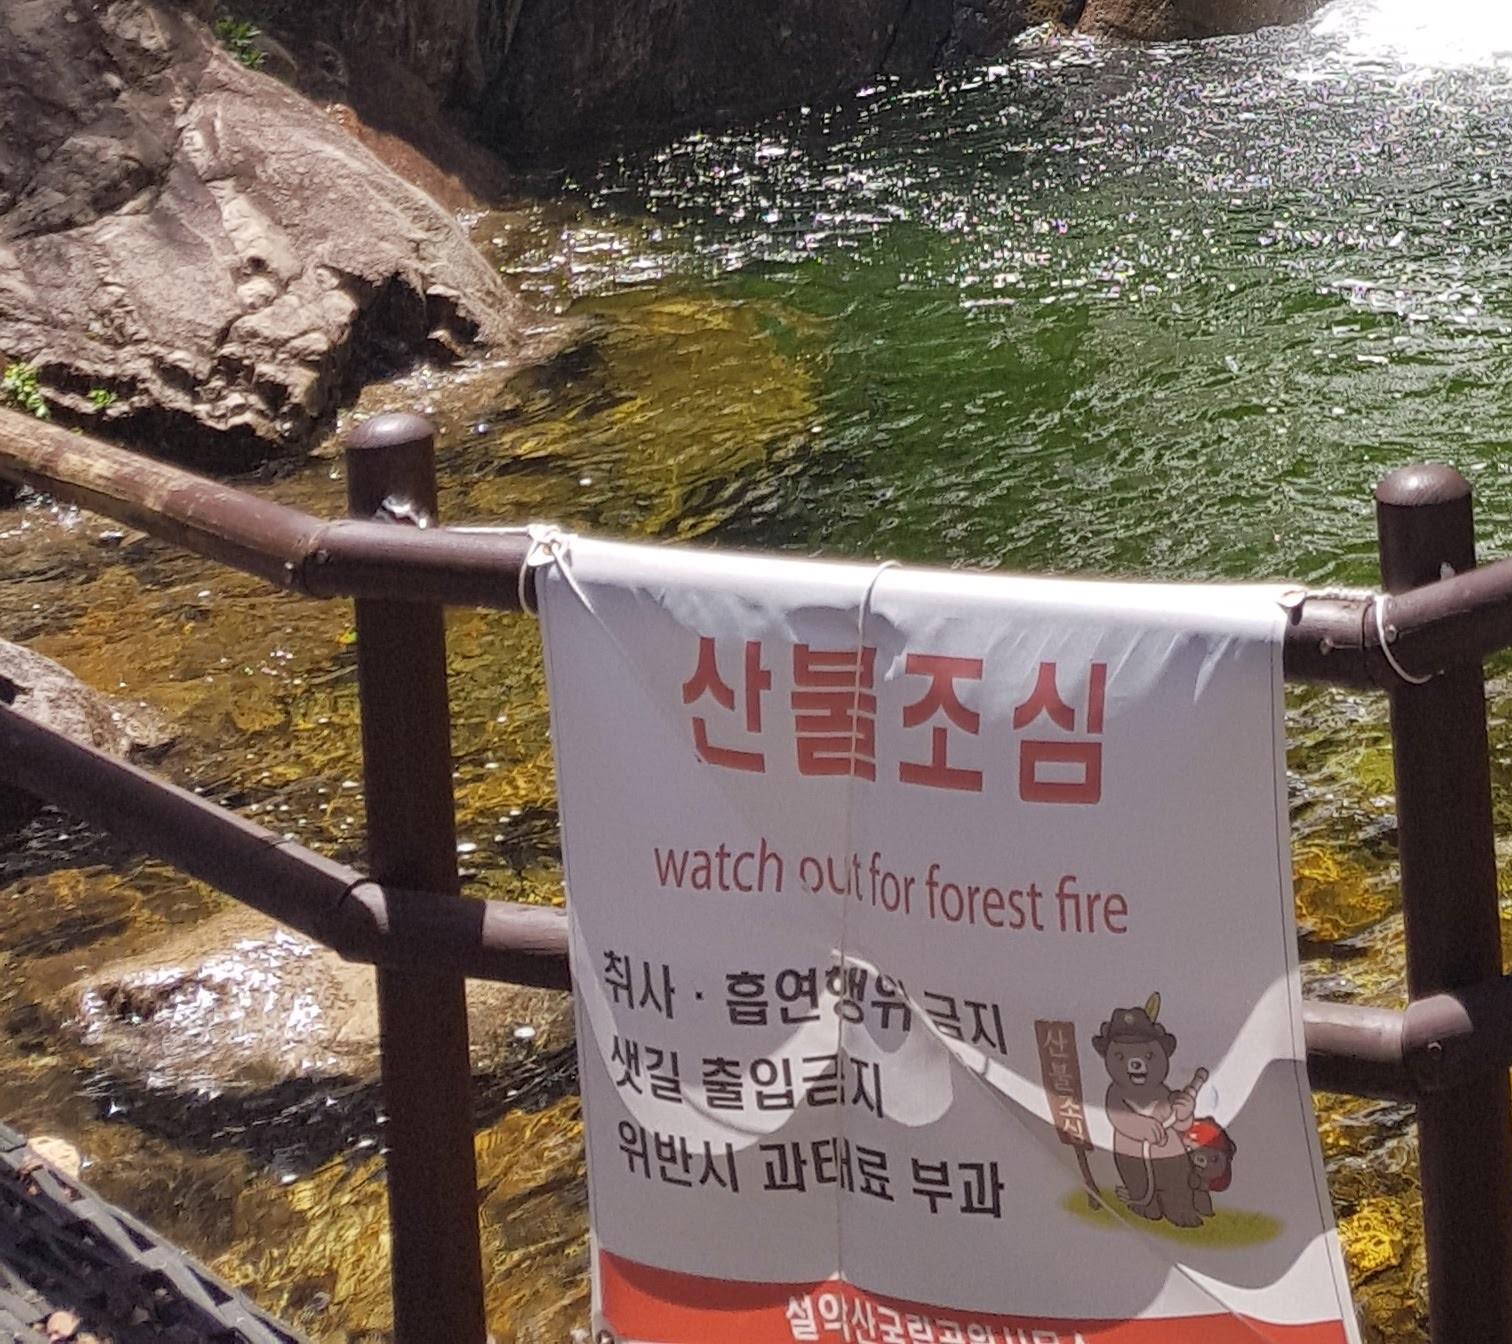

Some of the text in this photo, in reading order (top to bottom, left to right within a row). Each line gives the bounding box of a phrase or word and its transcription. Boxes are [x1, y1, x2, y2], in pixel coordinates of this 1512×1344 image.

[682, 636, 1108, 803] 산불조심
[654, 838, 1129, 934] watch out for forest fire
[603, 950, 676, 1019] 취사
[611, 1034, 885, 1118] 샛길 출입금지
[617, 1120, 1005, 1217] 위반시 과태료 부과
